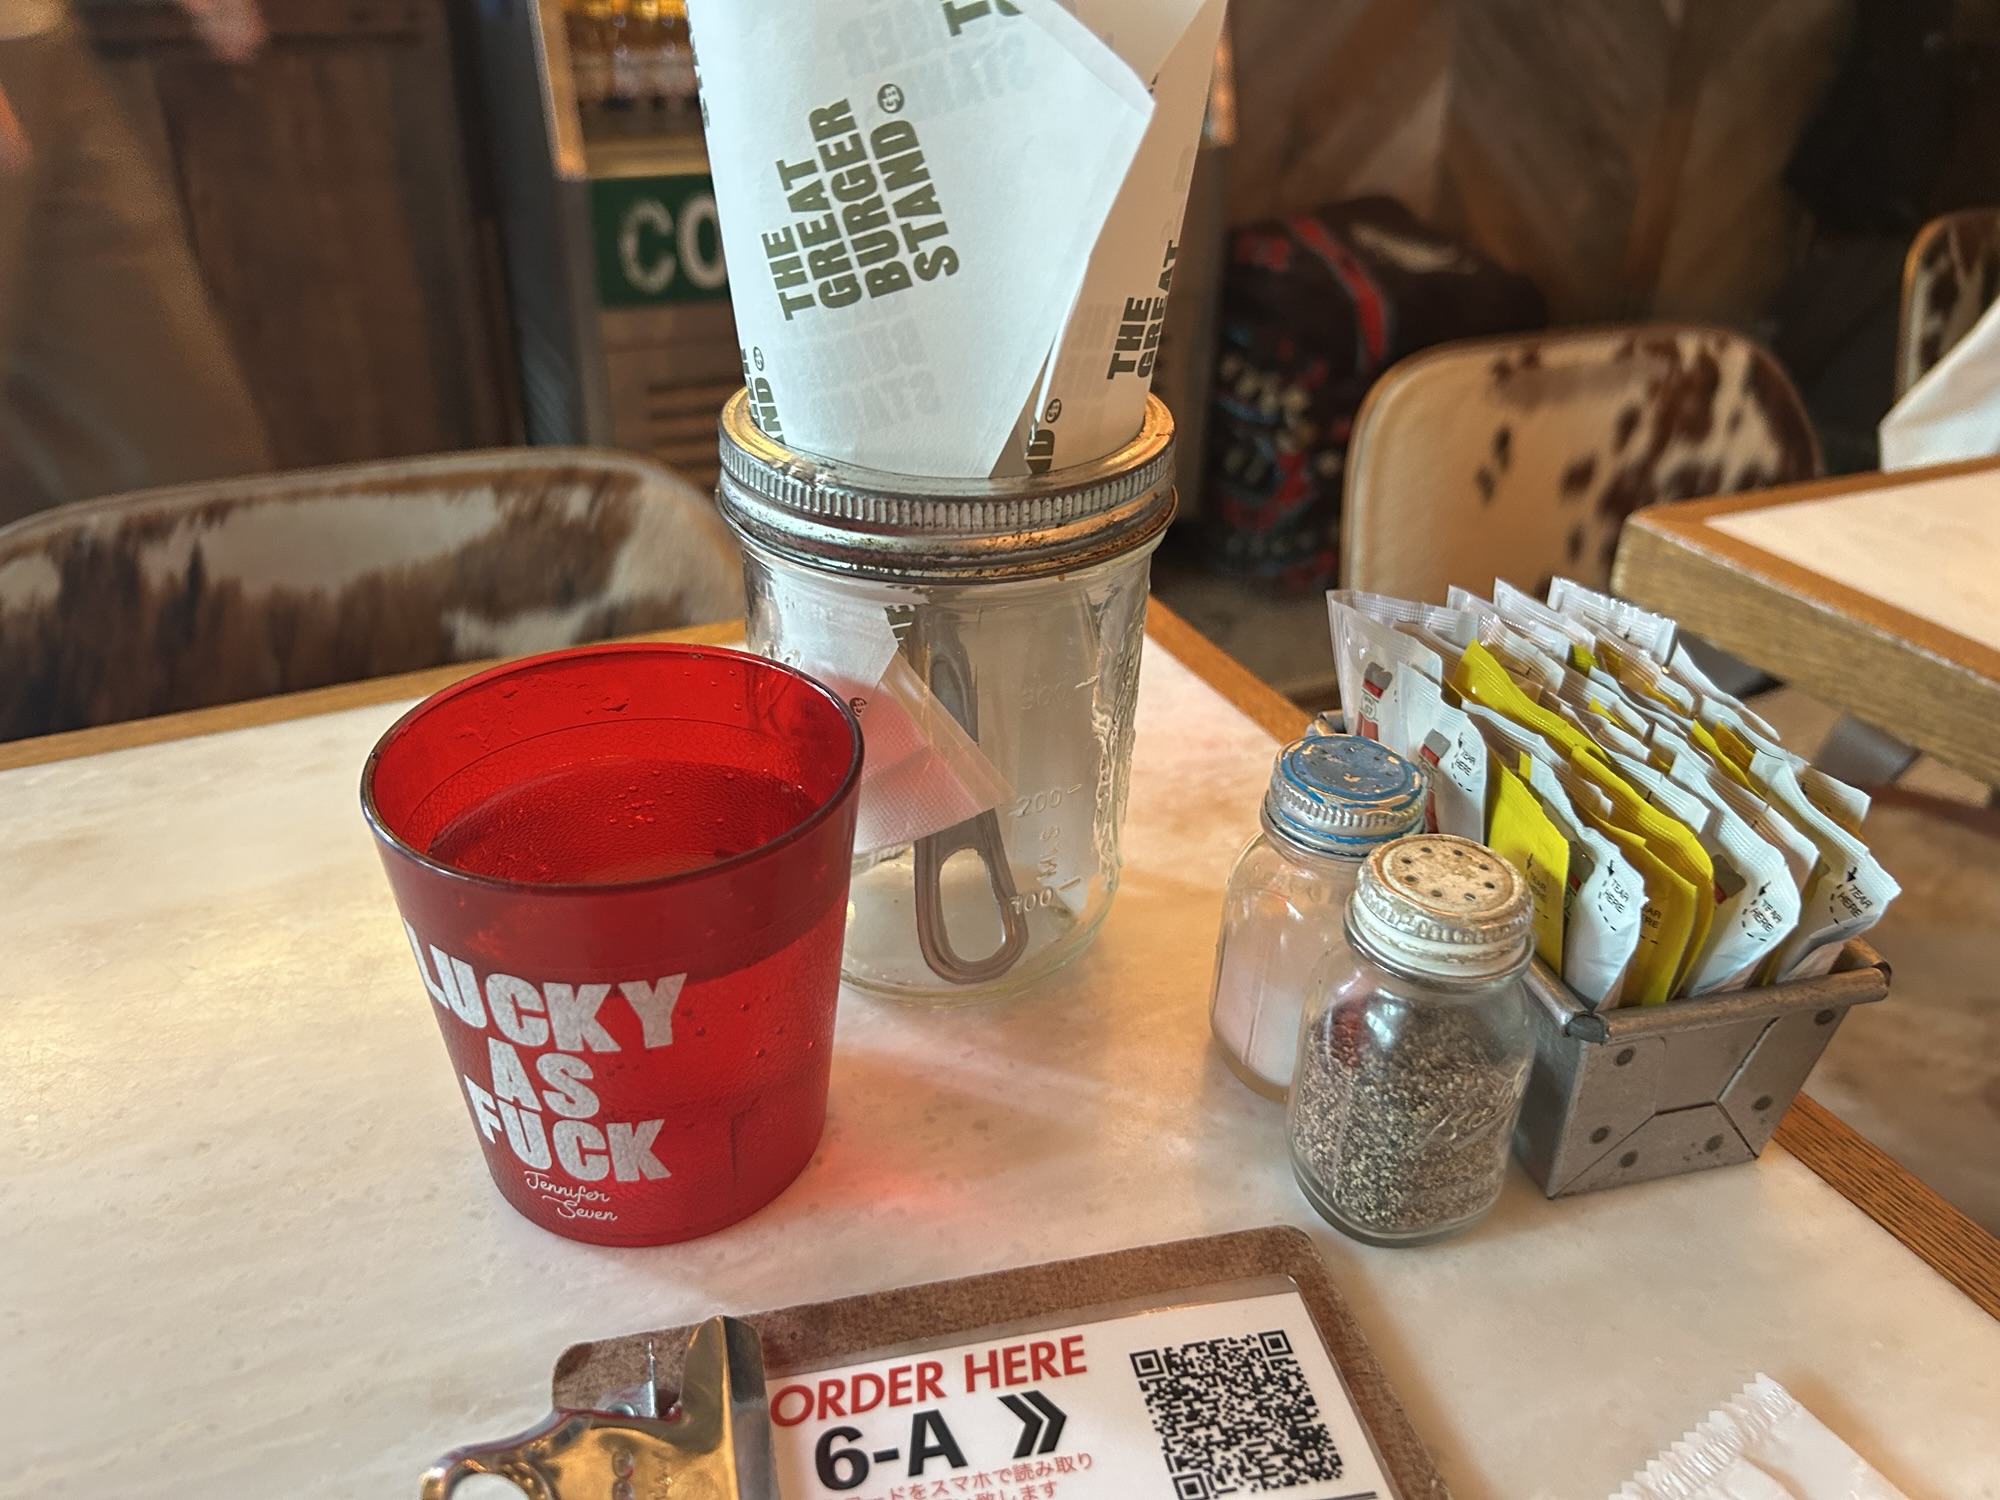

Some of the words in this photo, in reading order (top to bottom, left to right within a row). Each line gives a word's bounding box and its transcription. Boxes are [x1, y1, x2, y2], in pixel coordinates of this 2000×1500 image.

[775, 159, 862, 309] GREAT
[809, 98, 913, 298] BURGER
[870, 120, 959, 281] STAND
[761, 226, 816, 321] THE
[1106, 297, 1152, 379] THE
[1603, 889, 1625, 914] HERE
[1611, 879, 1630, 902] TEAR
[1750, 908, 1774, 932] HERE
[1762, 898, 1783, 923] TEAR
[1838, 892, 1863, 918] HERE
[1848, 884, 1874, 909] TEAR
[402, 917, 688, 1053] LUCKY
[487, 1036, 600, 1119] AS
[463, 1074, 672, 1182] FUCK
[524, 1171, 611, 1204] Jennifer
[541, 1195, 618, 1221] Seven
[770, 1361, 946, 1427] ORDER
[964, 1335, 1087, 1393] HERE
[815, 1409, 968, 1491] 6-A
